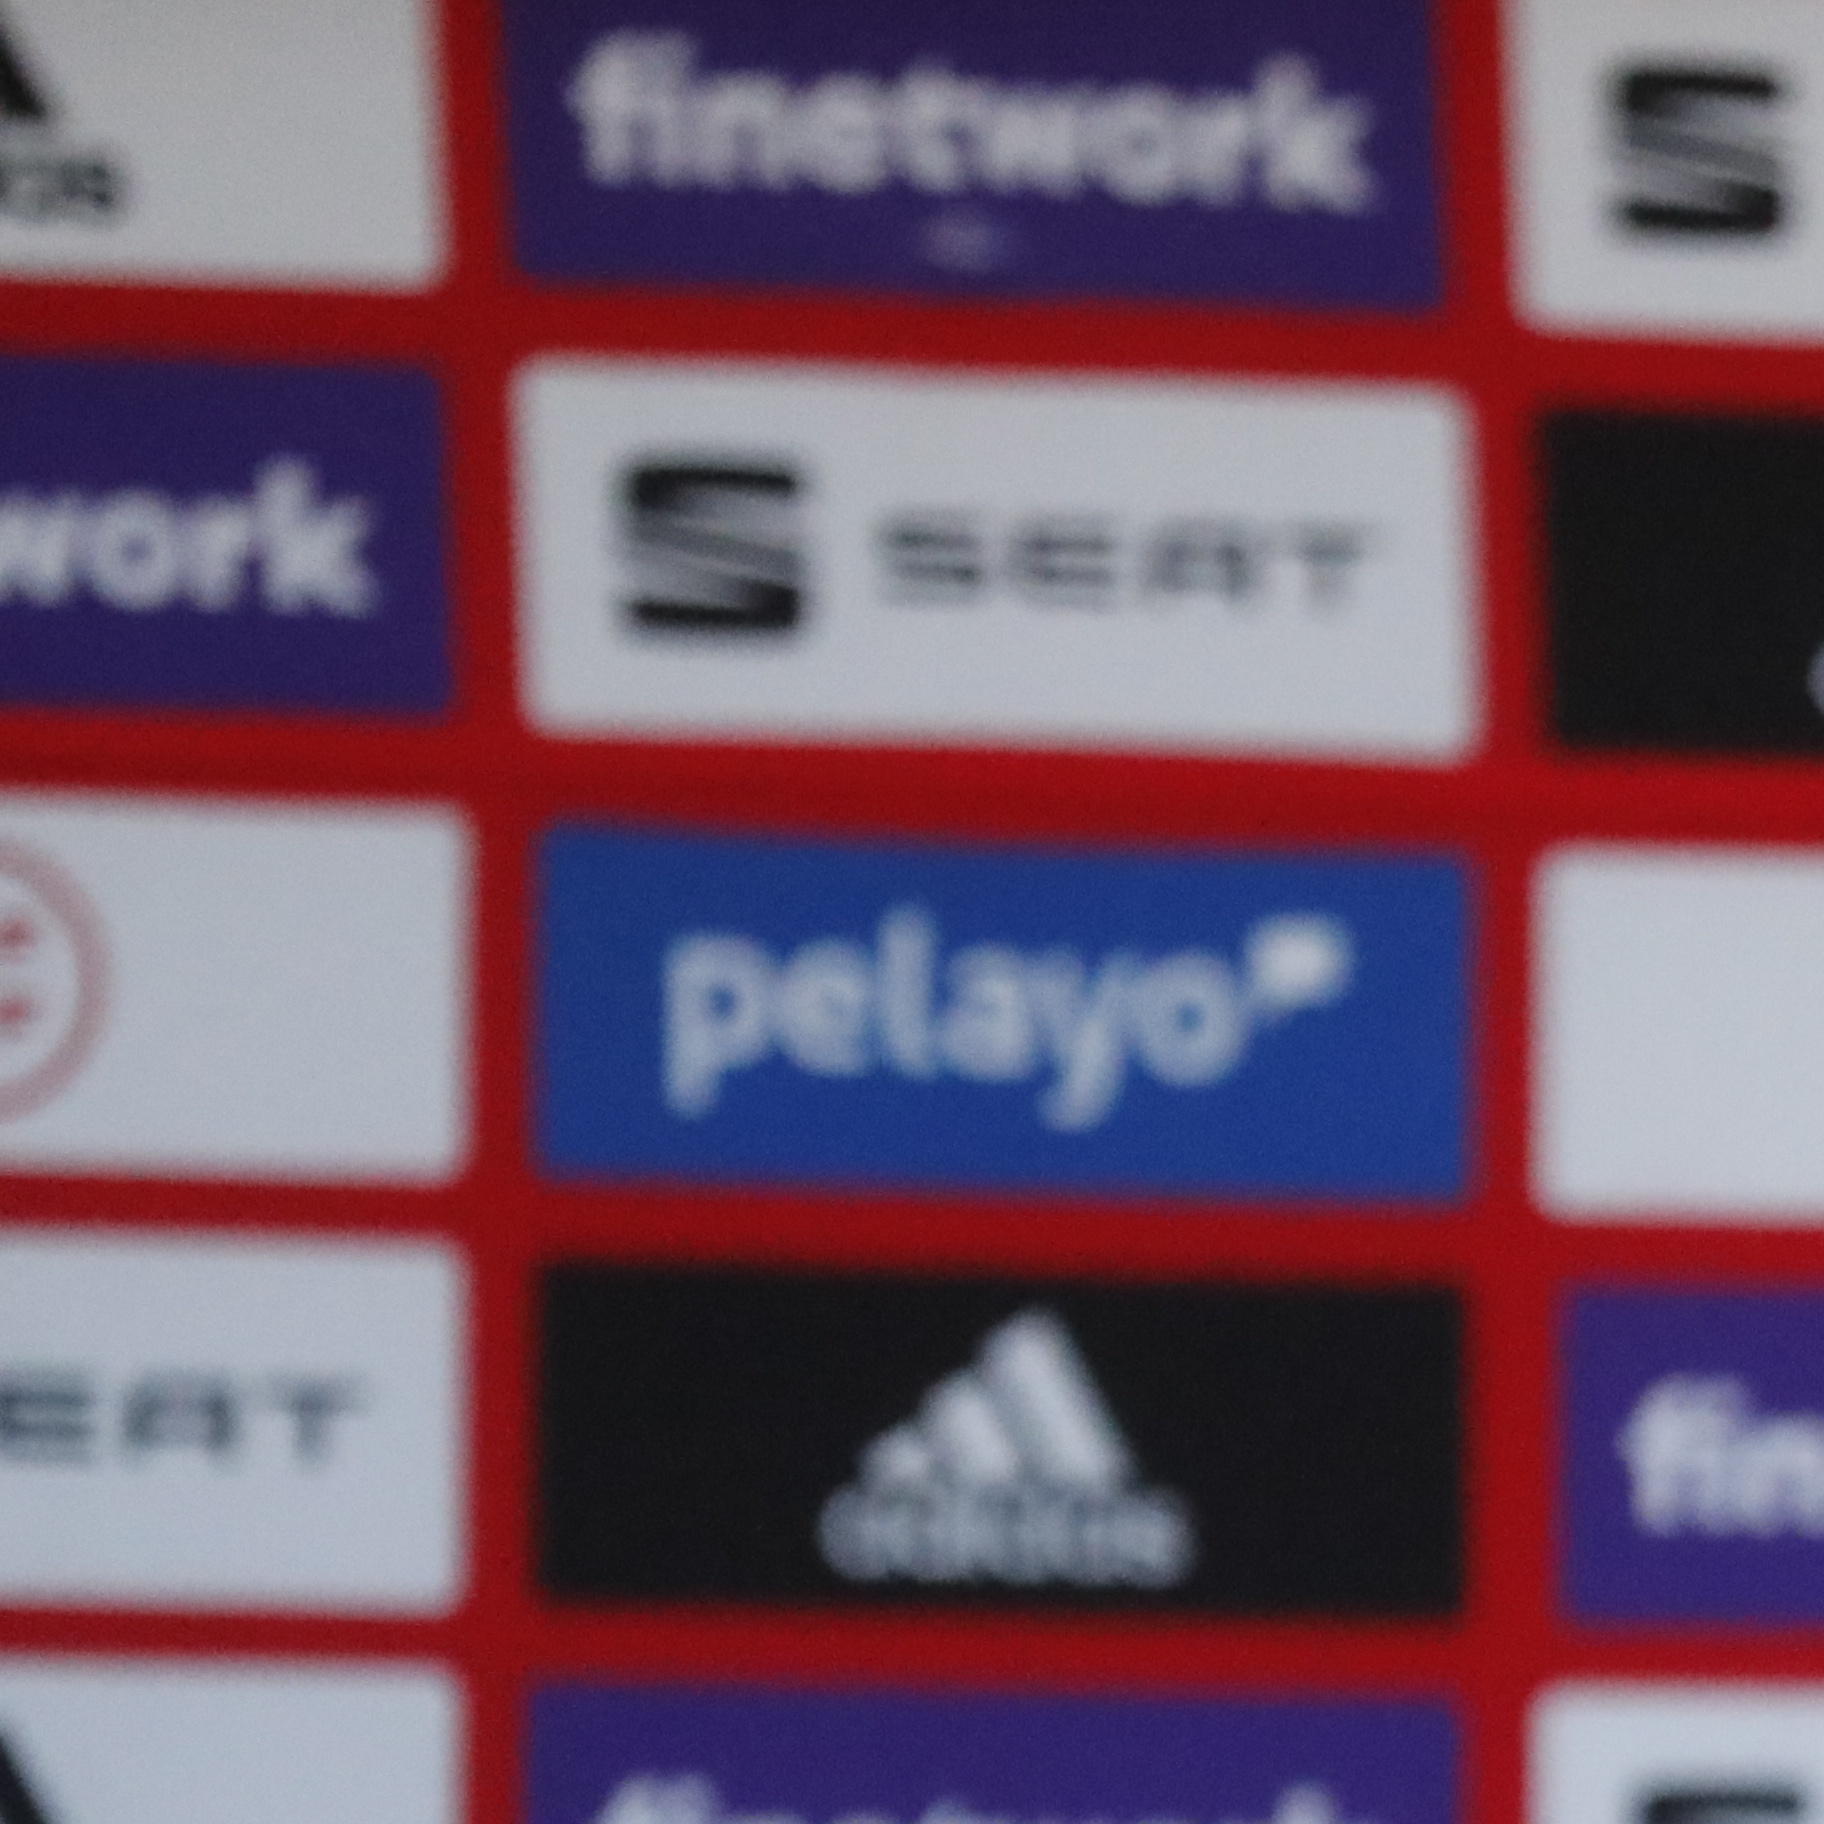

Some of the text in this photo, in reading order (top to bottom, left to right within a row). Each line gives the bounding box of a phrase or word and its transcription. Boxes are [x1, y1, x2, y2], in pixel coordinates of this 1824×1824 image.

[570, 35, 1372, 212] finetwork
[868, 502, 1376, 612] SEAT
[662, 908, 1258, 1130] pelayo
